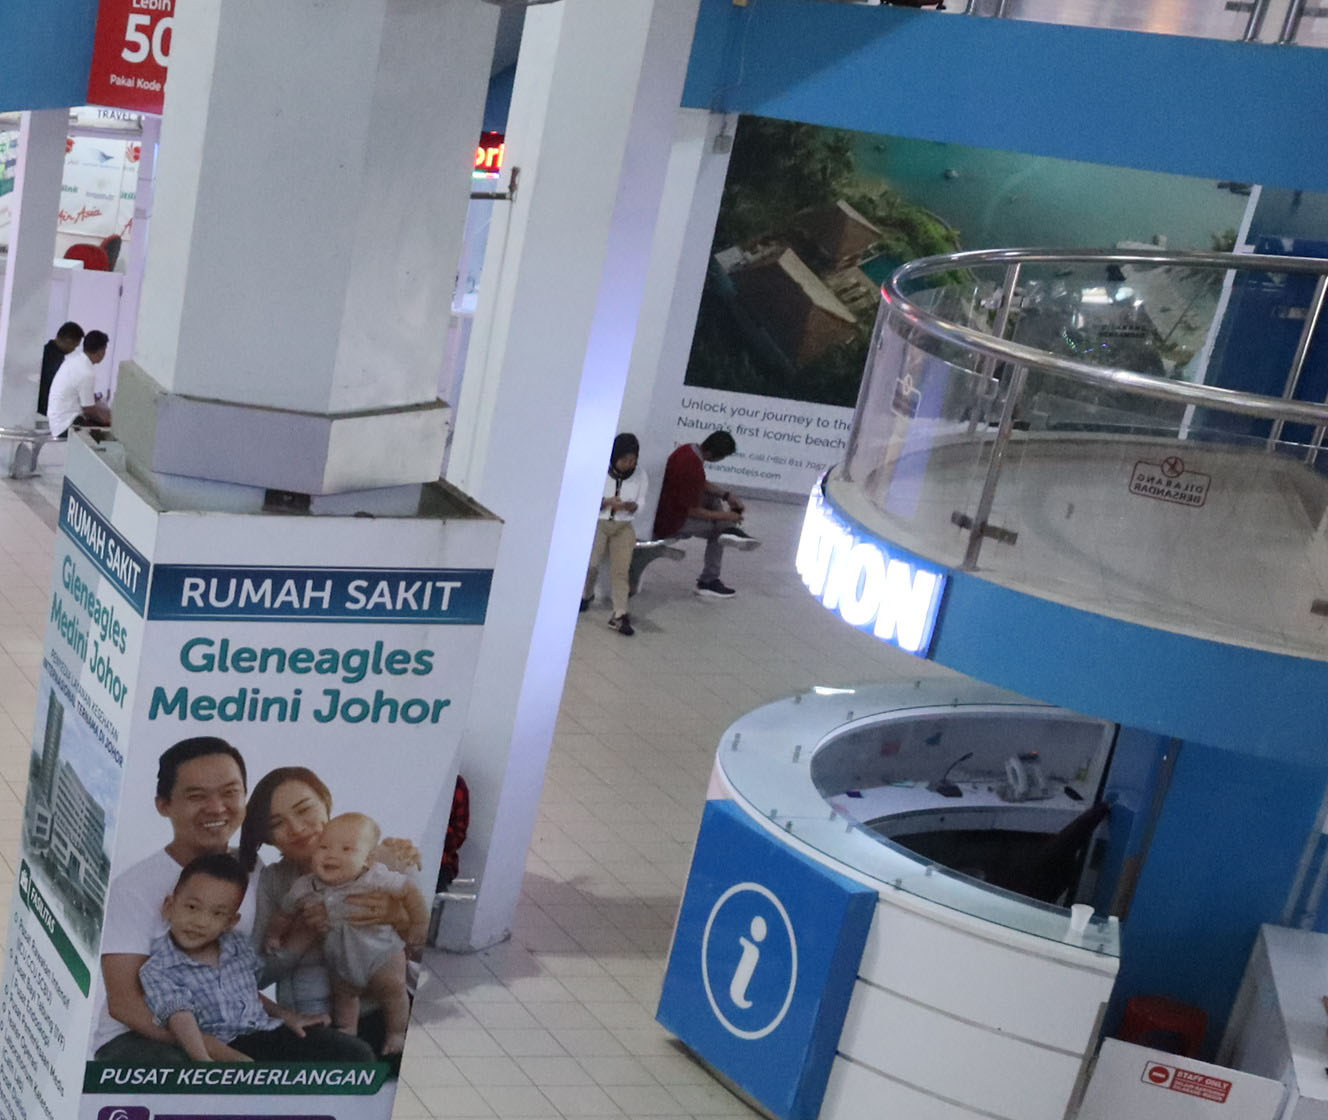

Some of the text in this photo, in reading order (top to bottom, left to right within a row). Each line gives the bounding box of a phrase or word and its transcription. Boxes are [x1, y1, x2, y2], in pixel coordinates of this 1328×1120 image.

[110, 74, 161, 91] Pakai Kode
[681, 398, 727, 414] Unlock
[730, 407, 760, 419] your
[761, 411, 813, 428] journey
[816, 417, 830, 428] to
[677, 416, 846, 449] Natuna's first iconic beach
[66, 494, 142, 594] RUMAH SAKIT
[62, 554, 128, 655] Gleneagles
[180, 577, 462, 611] RUMAH SAKIT
[50, 592, 128, 710] Medini Johor
[179, 636, 435, 684] Gleneagles
[148, 685, 451, 724] Medini Johor
[30, 886, 56, 935] FASILITAS
[99, 1068, 375, 1086] PUSAT KECEMERLANGAN
[1177, 1071, 1229, 1088] STAFF ONLY
